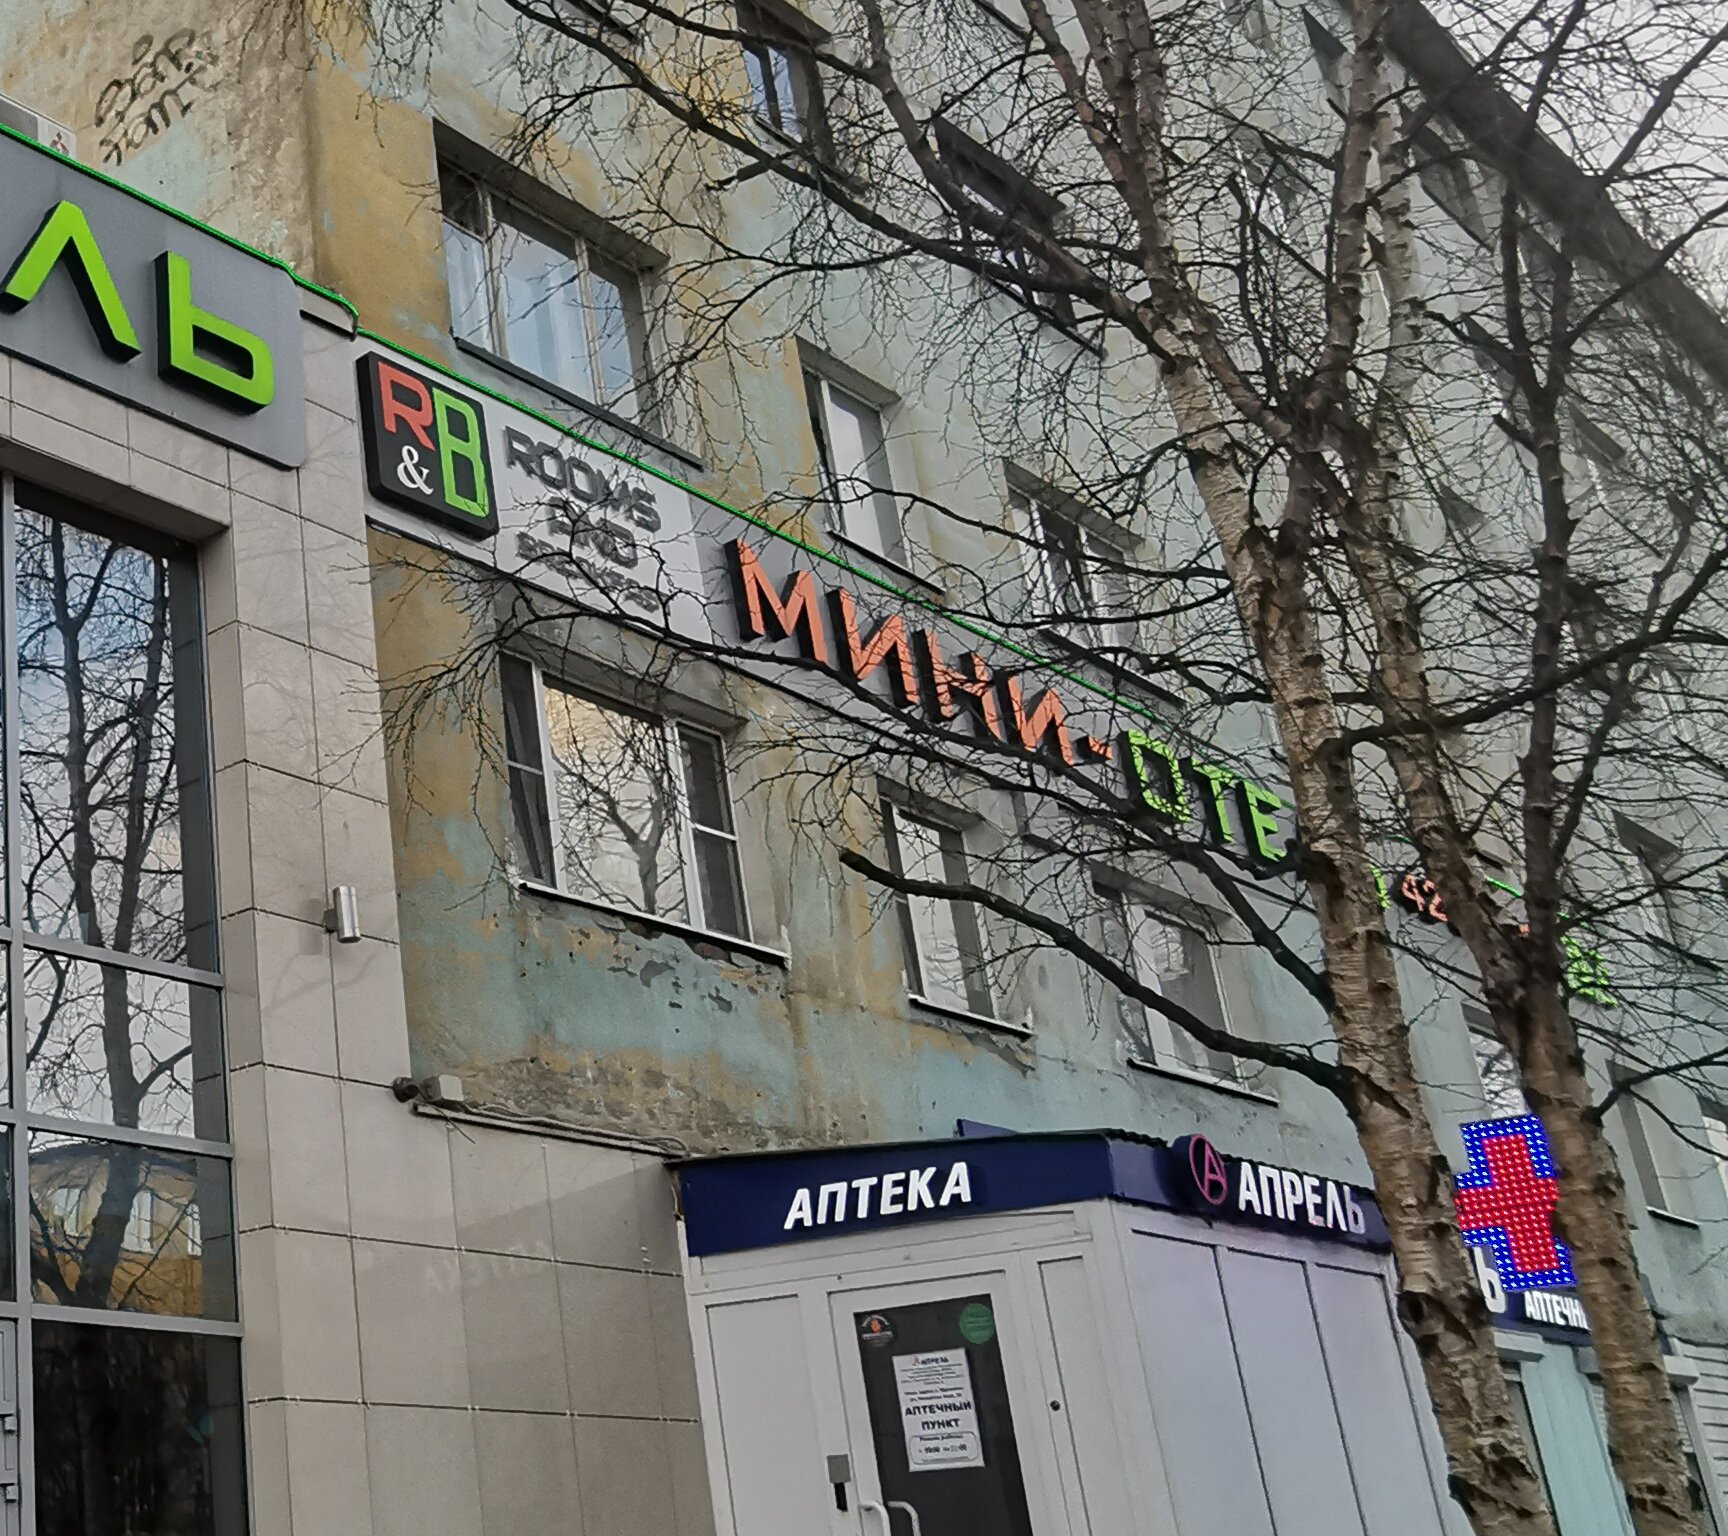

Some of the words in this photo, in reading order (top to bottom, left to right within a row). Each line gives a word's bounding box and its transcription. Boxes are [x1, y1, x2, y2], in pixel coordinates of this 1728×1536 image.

[504, 425, 662, 533] ROOMS
[724, 537, 1390, 910] МИНИ-ОТЕ
[783, 1161, 972, 1231] АПТЕКА
[1238, 1161, 1366, 1235] АПРЕЛЬ
[1524, 1290, 1592, 1332] АПТЕЧН
[905, 1401, 972, 1416] АПТЕЧНЫЙ
[920, 1418, 961, 1431] ПУНКТ
